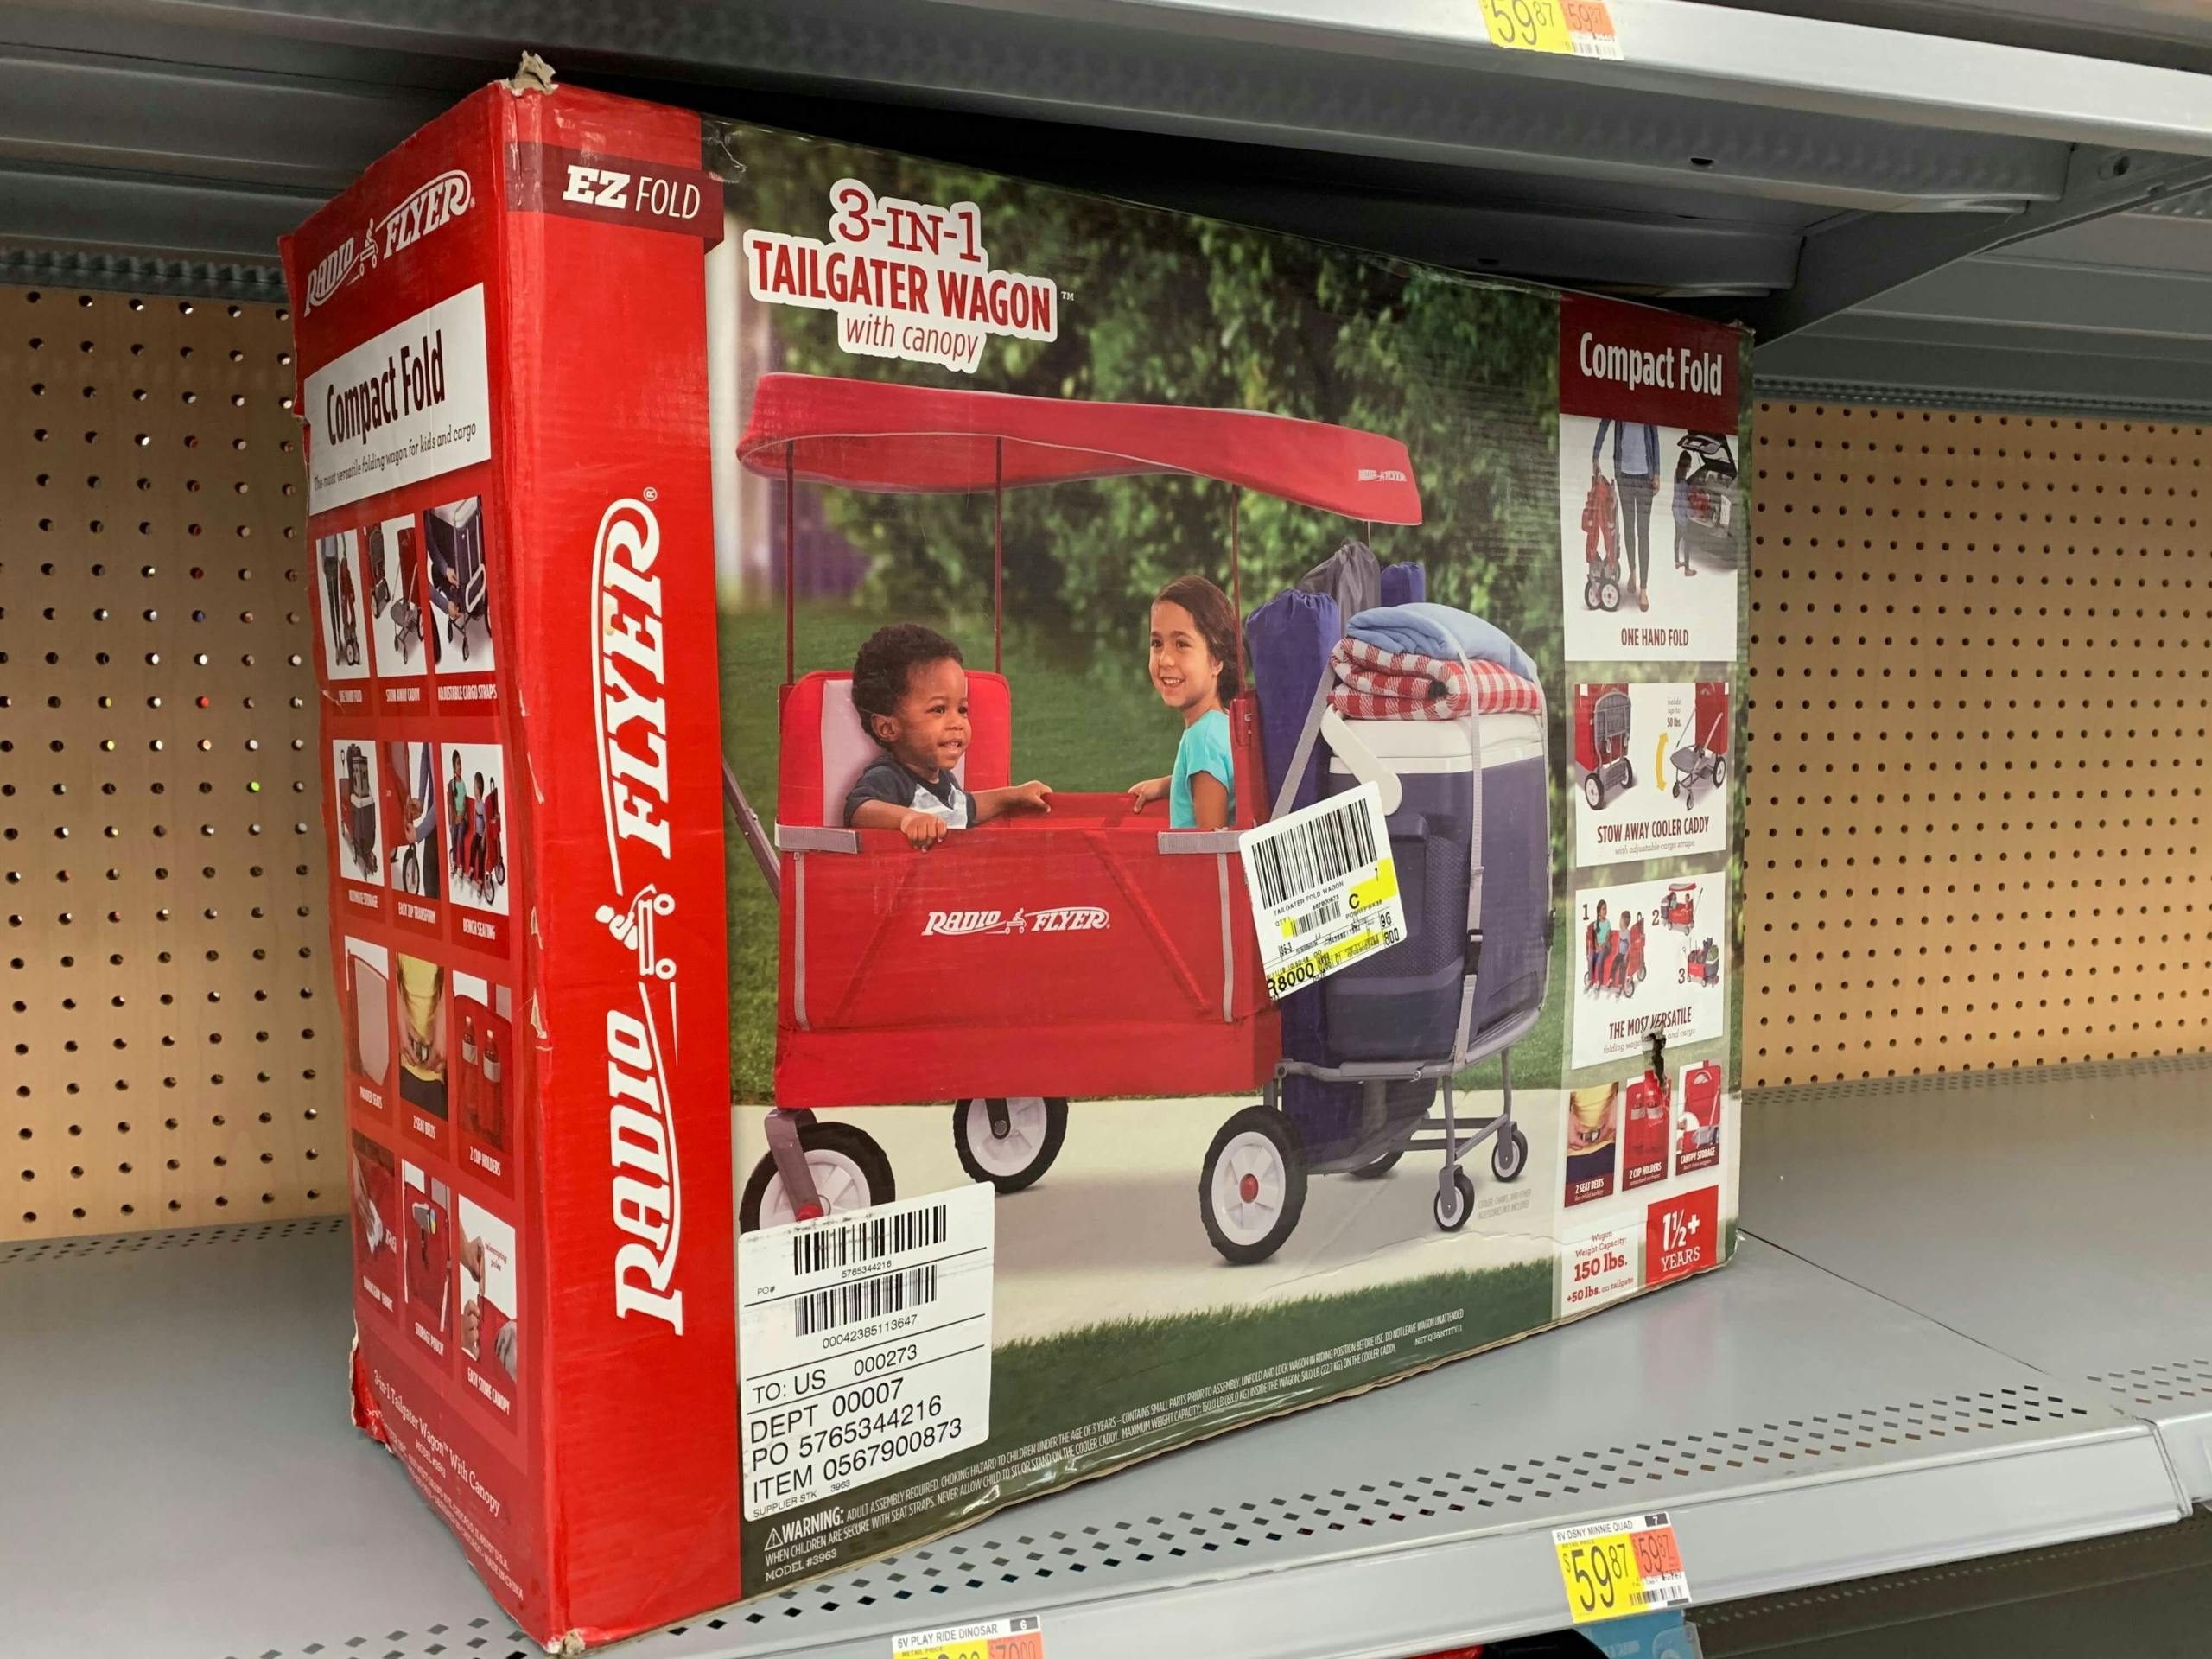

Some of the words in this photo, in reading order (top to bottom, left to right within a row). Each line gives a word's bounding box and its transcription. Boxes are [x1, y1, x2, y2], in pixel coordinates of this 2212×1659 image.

[563, 164, 630, 209] EZ
[636, 176, 700, 219] FOLD
[838, 188, 981, 263] 3-IN-1
[304, 237, 356, 317] RADIO
[380, 169, 471, 259] FLYER
[753, 240, 929, 314] TAILGATER
[937, 270, 1051, 333] WAGON
[846, 315, 895, 348] with
[903, 326, 978, 364] canopy
[1580, 331, 1674, 391] Compact
[1680, 348, 1722, 396] Fold
[327, 355, 398, 445] Compact
[400, 329, 446, 416] Fold
[362, 455, 385, 473] folding
[385, 448, 408, 467] wagon
[409, 440, 419, 456] for
[420, 432, 435, 453] kids
[437, 425, 451, 447] and
[454, 423, 476, 442] cargo
[1621, 628, 1639, 647] ONE
[1642, 628, 1666, 647] HAND
[1669, 628, 1688, 647] FOLD
[592, 498, 671, 866] FLYER
[1597, 824, 1623, 843] STOW
[1624, 821, 1650, 841] AWAY
[1651, 818, 1681, 838] COOLER
[1684, 816, 1710, 835] CADDY
[1274, 899, 1305, 917] TAILGATER
[1306, 891, 1321, 903] FOLD
[1322, 881, 1344, 894] WAGON
[1349, 893, 1360, 909] C
[1583, 904, 1590, 920] 1
[921, 911, 1004, 936] RADIO
[1027, 906, 1109, 931] FLYER
[1652, 909, 1660, 926] 2
[1678, 968, 1685, 984] 3
[1609, 1021, 1624, 1040] THE
[1627, 1015, 1649, 1037] MOST
[1650, 1007, 1692, 1029] VERSATILE
[1633, 1168, 1642, 1179] CUP
[1642, 1161, 1662, 1176] HOLDERS
[1697, 1147, 1715, 1160] STORAGE
[607, 1008, 683, 1336] RADIO
[1580, 1181, 1590, 1193] SEAT
[1591, 1178, 1604, 1191] BELTS
[1575, 1245, 1598, 1258] Weight
[1599, 1237, 1627, 1252] Capacity:
[1661, 1246, 1700, 1272] YEARS
[842, 1260, 892, 1278] 5765344216
[1574, 1257, 1600, 1281] 150
[1604, 1251, 1628, 1272] lbs.
[1567, 1291, 1583, 1303] +50
[1585, 1285, 1600, 1299] lbs.
[1611, 1277, 1634, 1292] tailgate
[823, 1314, 917, 1349] 00042385113647
[1414, 1336, 1427, 1346] NET
[753, 1382, 786, 1404] TO:
[794, 1369, 826, 1395] US
[855, 1344, 918, 1376] 000273
[750, 1404, 818, 1444] DEPT
[832, 1377, 904, 1417] 00007
[782, 1506, 844, 1543] WARNING:
[846, 1503, 869, 1522] ADULT
[870, 1490, 907, 1512] ASSEMBLY
[906, 1478, 939, 1500] REQUIRED.
[941, 1469, 969, 1488] CHOKING
[970, 1458, 996, 1477] HAZARD
[997, 1455, 1007, 1466] TO
[1007, 1444, 1037, 1464] CHILDREN
[1037, 1435, 1058, 1452] UNDER
[1058, 1432, 1070, 1444] THE
[1071, 1427, 1083, 1441] AGE
[1084, 1425, 1091, 1437] OF
[1097, 1417, 1116, 1433] YEARS
[1122, 1406, 1151, 1424] CONTAINS
[1151, 1401, 1167, 1415] SMALL
[1169, 1394, 1186, 1408] PARTS
[1187, 1389, 1205, 1403] PRIOR
[1205, 1385, 1212, 1396] TO
[1242, 1370, 1262, 1386] UNFOLD
[1263, 1368, 1275, 1379] AND
[1275, 1363, 1288, 1376] LOCK
[1289, 1357, 1309, 1371] WAGON
[1357, 1337, 1374, 1351] BEFORE
[1393, 1327, 1402, 1339] NOT
[1402, 1322, 1417, 1337] LEAVE
[1417, 1317, 1435, 1331] WAGON
[1435, 1308, 1464, 1325] UNATTENDED
[753, 1442, 788, 1471] PO
[799, 1395, 942, 1458] 5765344216
[391, 1387, 419, 1429] Tailgater
[419, 1417, 444, 1457] Wagon
[449, 1449, 468, 1483] With
[469, 1471, 500, 1517] Canopy
[753, 1465, 812, 1503] ITEM
[823, 1417, 962, 1481] 0567900873
[765, 1546, 790, 1567] WHEN
[791, 1536, 826, 1558] CHILDREN
[828, 1529, 842, 1545] ARE
[843, 1519, 870, 1539] SECURE
[871, 1511, 891, 1529] WITH
[891, 1505, 907, 1522] SEAT
[908, 1497, 937, 1516] STRAPS.
[938, 1488, 958, 1507] NEVER
[959, 1478, 982, 1496] ALLOW
[983, 1471, 1001, 1487] CHILD
[1002, 1468, 1010, 1480] TO
[1021, 1462, 1031, 1473] OR
[1031, 1455, 1052, 1471] STAND
[1052, 1450, 1063, 1463] ON
[1063, 1446, 1074, 1459] THE
[1075, 1438, 1097, 1455] COOLER
[1122, 1420, 1151, 1439] MAXIMUM
[1151, 1413, 1173, 1429] WEIGHT
[1173, 1406, 1202, 1423] CAPACITY:
[1249, 1384, 1268, 1397] INSIDE
[1268, 1381, 1279, 1392] THE
[1301, 1370, 1313, 1382] 50.0
[1351, 1353, 1361, 1365] THE
[1361, 1348, 1379, 1362] COOLER
[753, 1496, 798, 1517] SUPPLIER
[800, 1491, 818, 1503] STK
[830, 1480, 850, 1492] 3963
[1557, 1530, 1566, 1541] 6V
[1567, 1528, 1586, 1540] DSNY
[1587, 1523, 1611, 1537] MINNIE
[1612, 1520, 1633, 1532] QUAD
[1652, 1516, 1658, 1526] 7
[766, 1560, 804, 1582] MODEL
[806, 1548, 837, 1567] #3963
[898, 1637, 909, 1649] 6V
[912, 1634, 933, 1646] PLAY
[936, 1630, 956, 1643] RIDE
[958, 1624, 997, 1639] DINOSAR
[1020, 1620, 1027, 1630] 6
